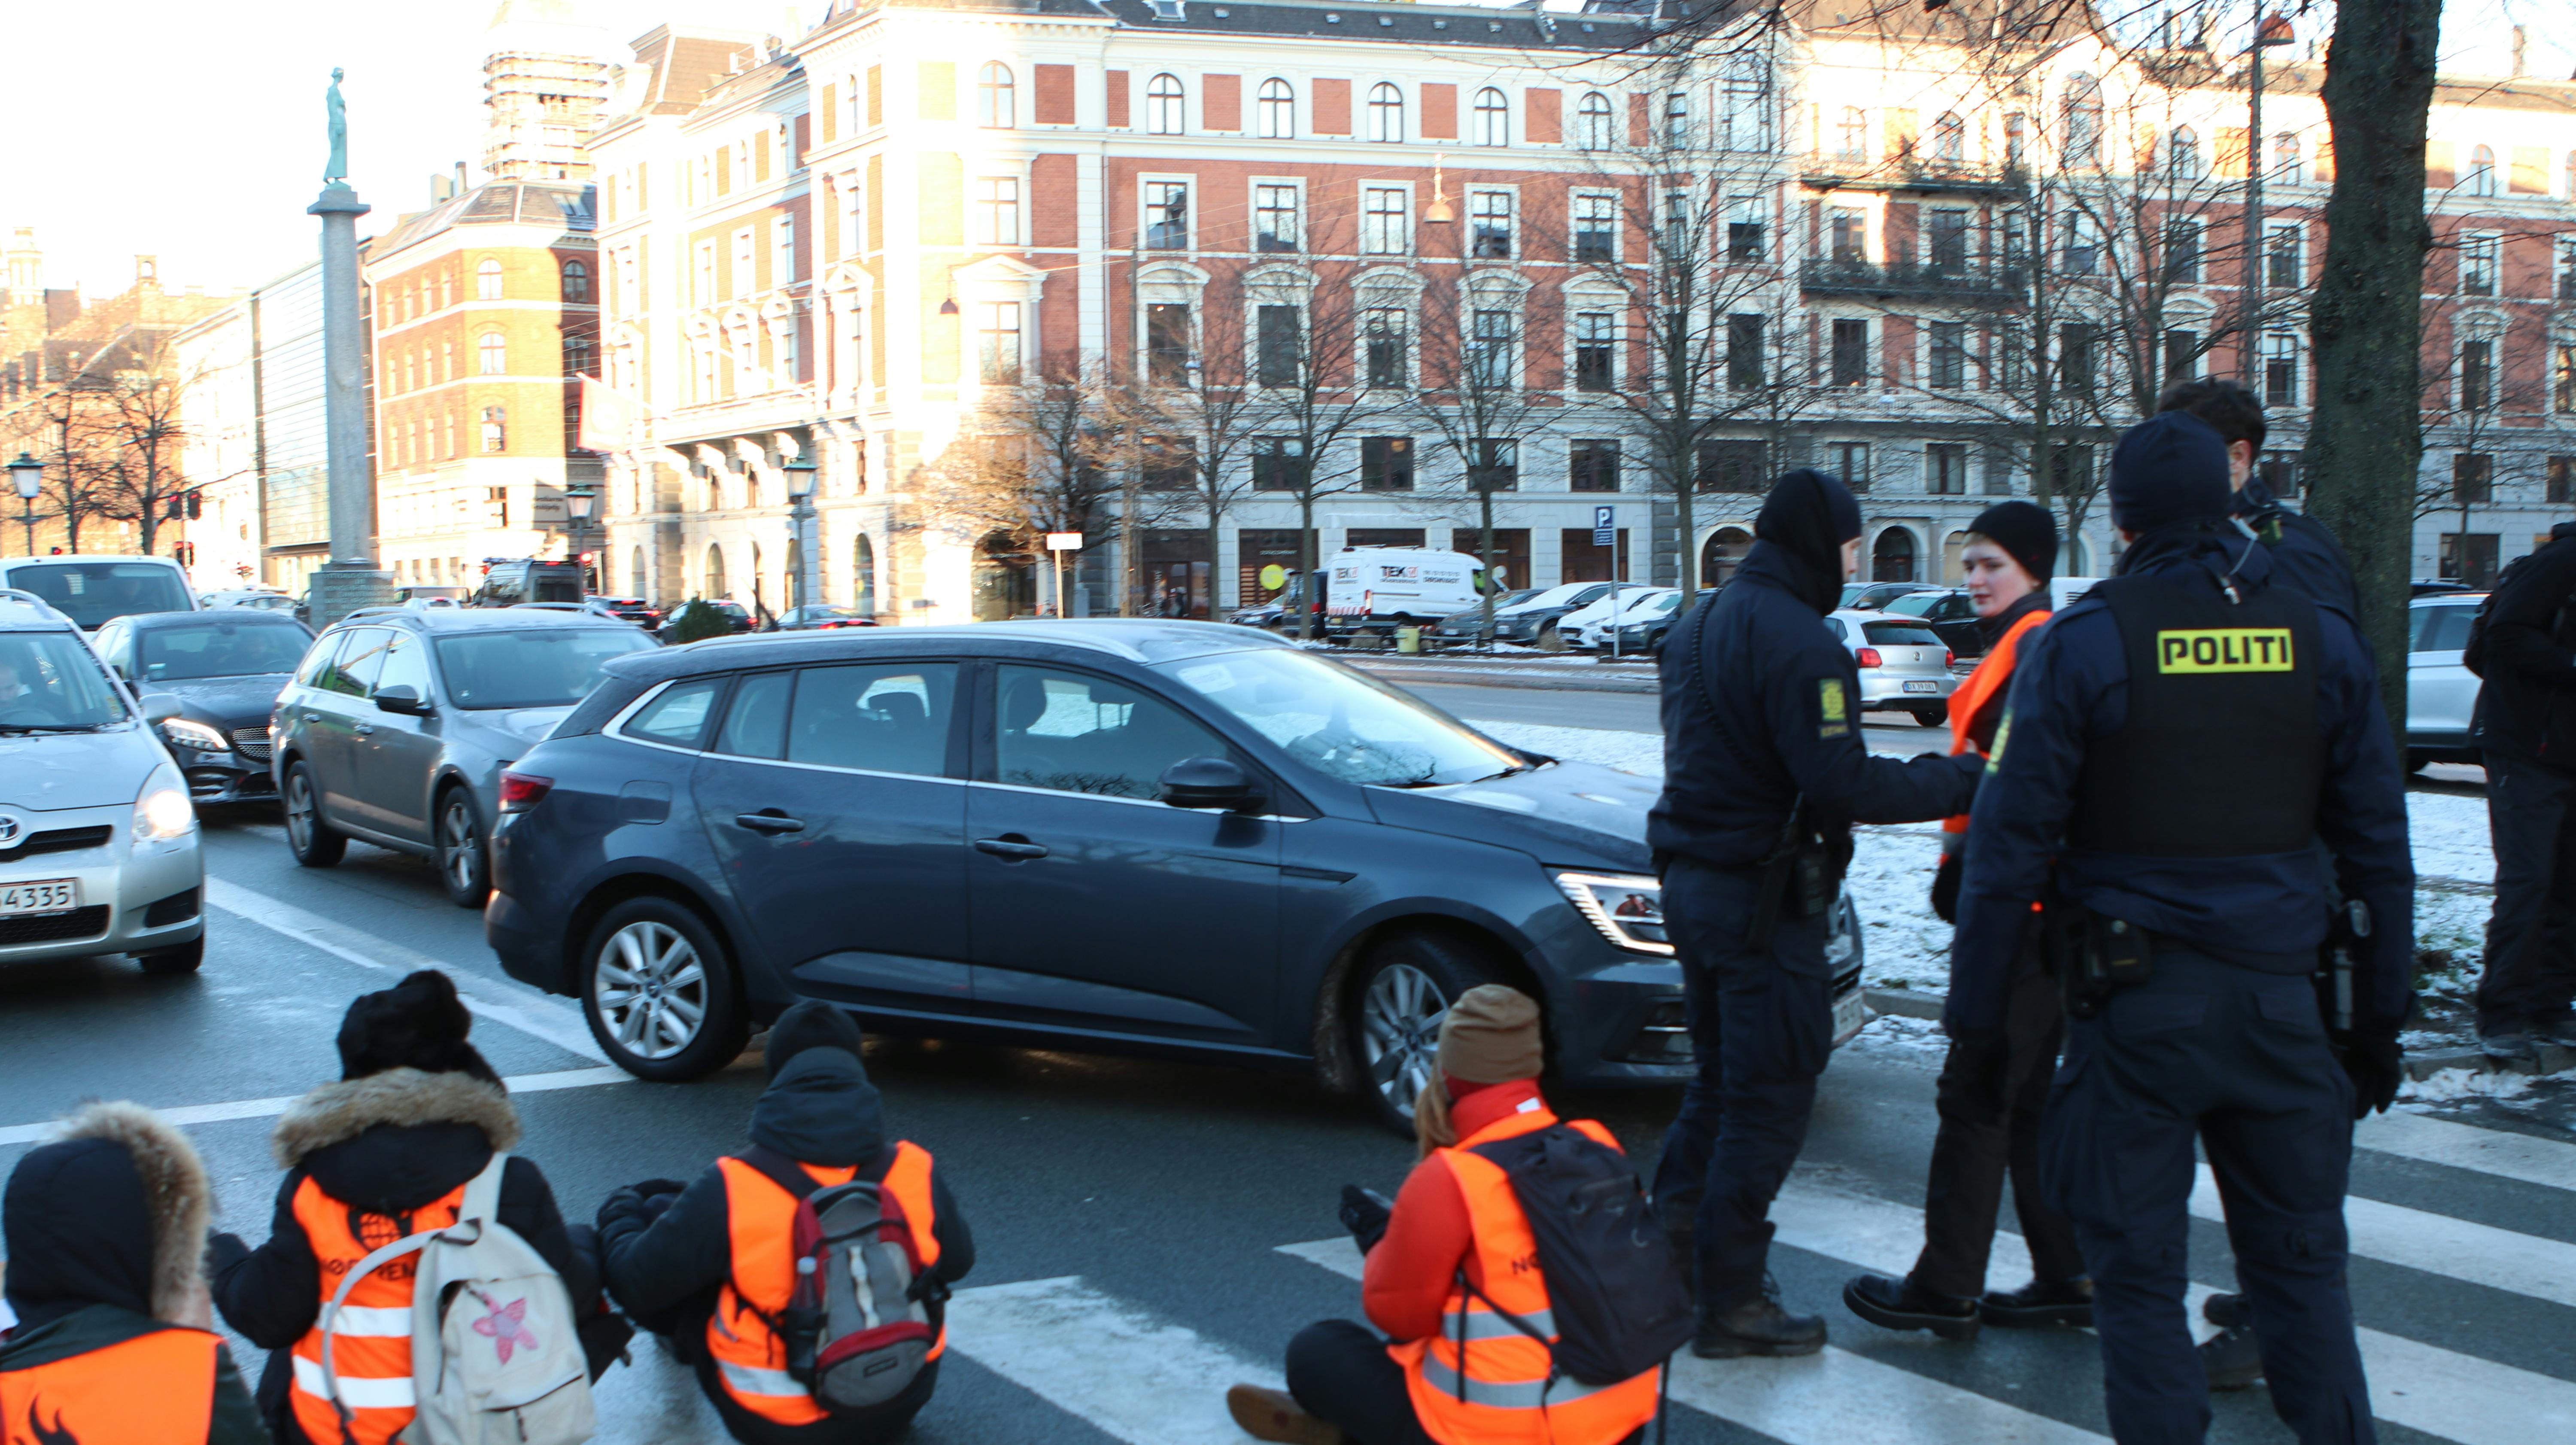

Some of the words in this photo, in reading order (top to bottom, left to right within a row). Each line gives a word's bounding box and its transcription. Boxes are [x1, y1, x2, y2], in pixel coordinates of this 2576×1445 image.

[1598, 508, 1611, 528] P
[2163, 636, 2288, 666] POLITI
[0, 885, 70, 909] 4335
